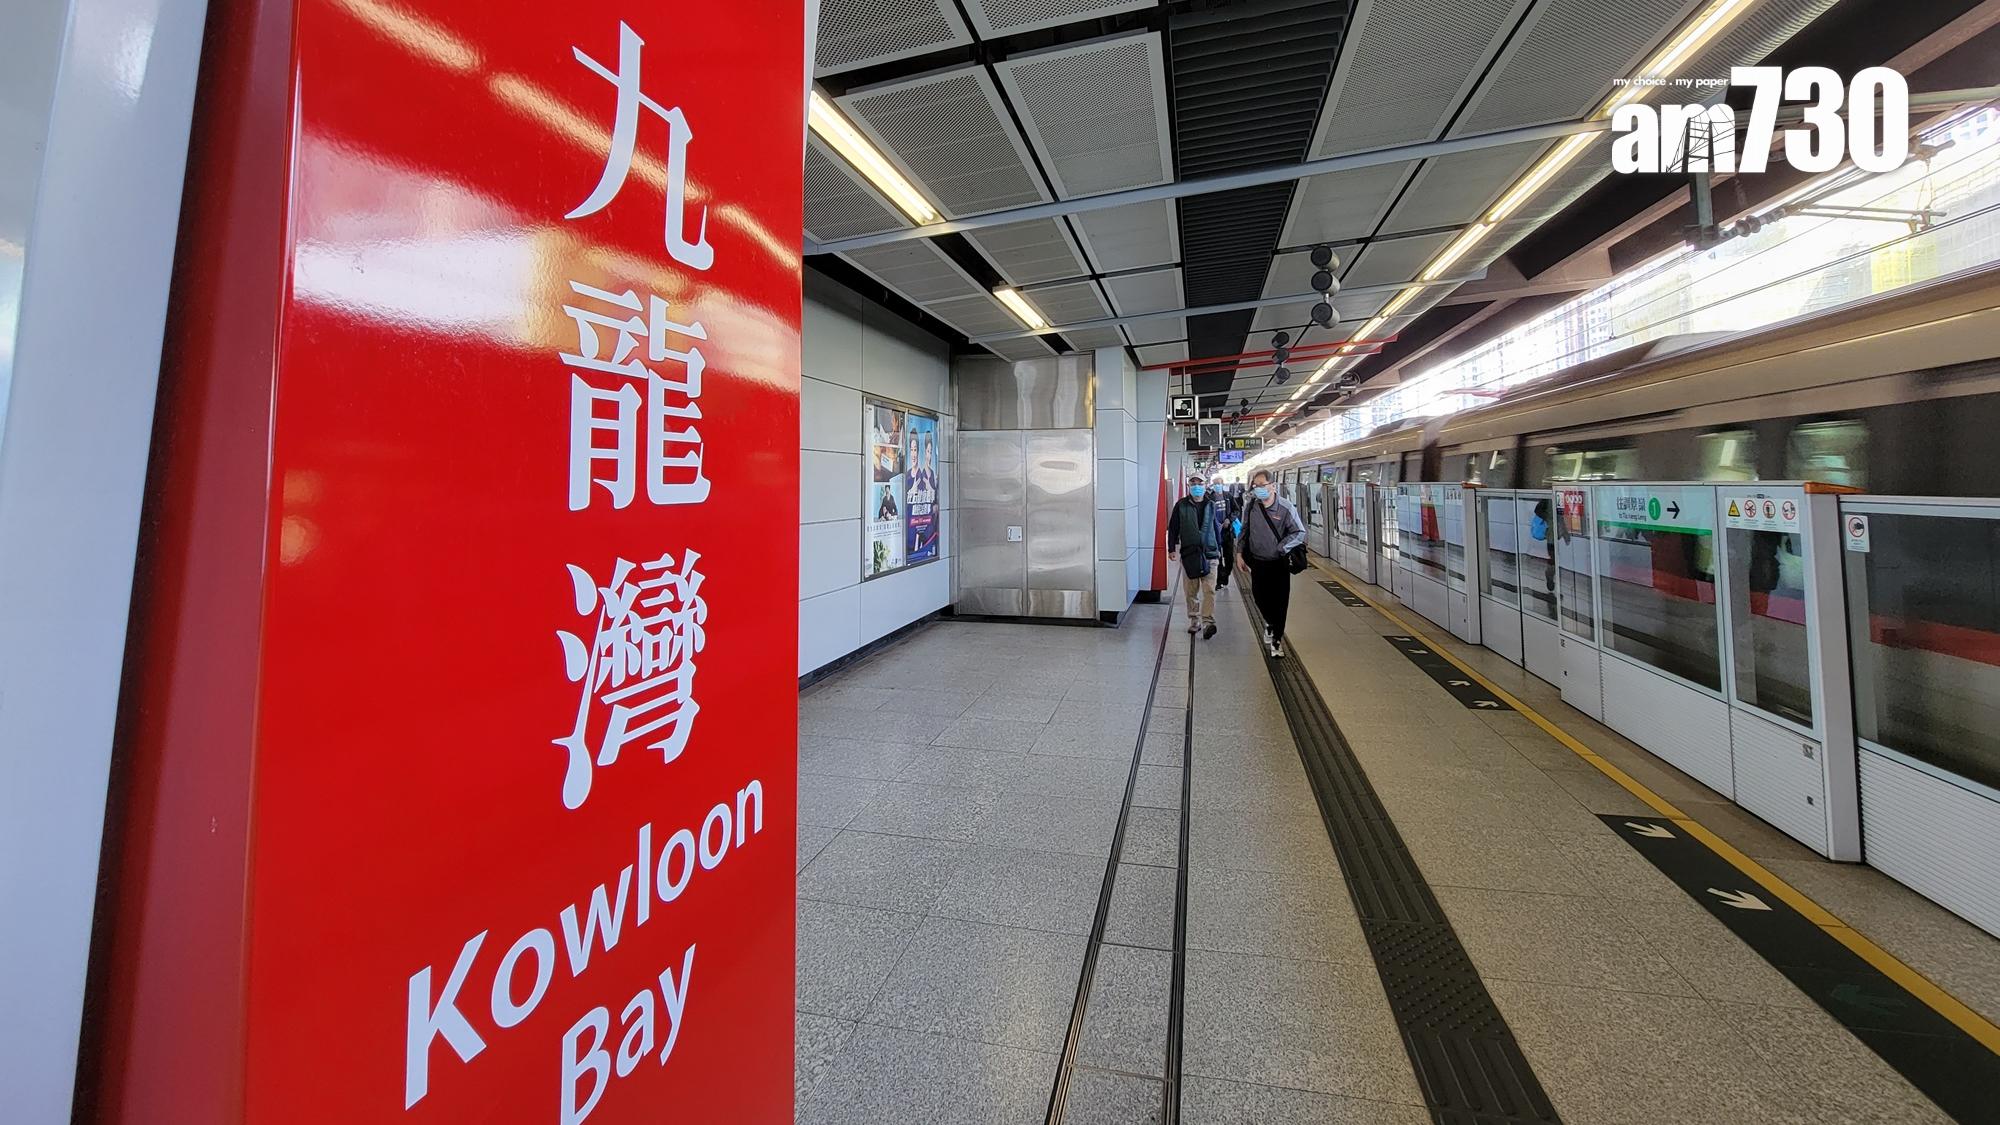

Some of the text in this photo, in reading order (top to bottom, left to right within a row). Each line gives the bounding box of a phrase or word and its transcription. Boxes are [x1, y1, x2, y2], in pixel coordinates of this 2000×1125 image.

[552, 20, 714, 809] 九龍灣
[404, 779, 763, 1111] Kowloon
[560, 943, 696, 1125] Bay
